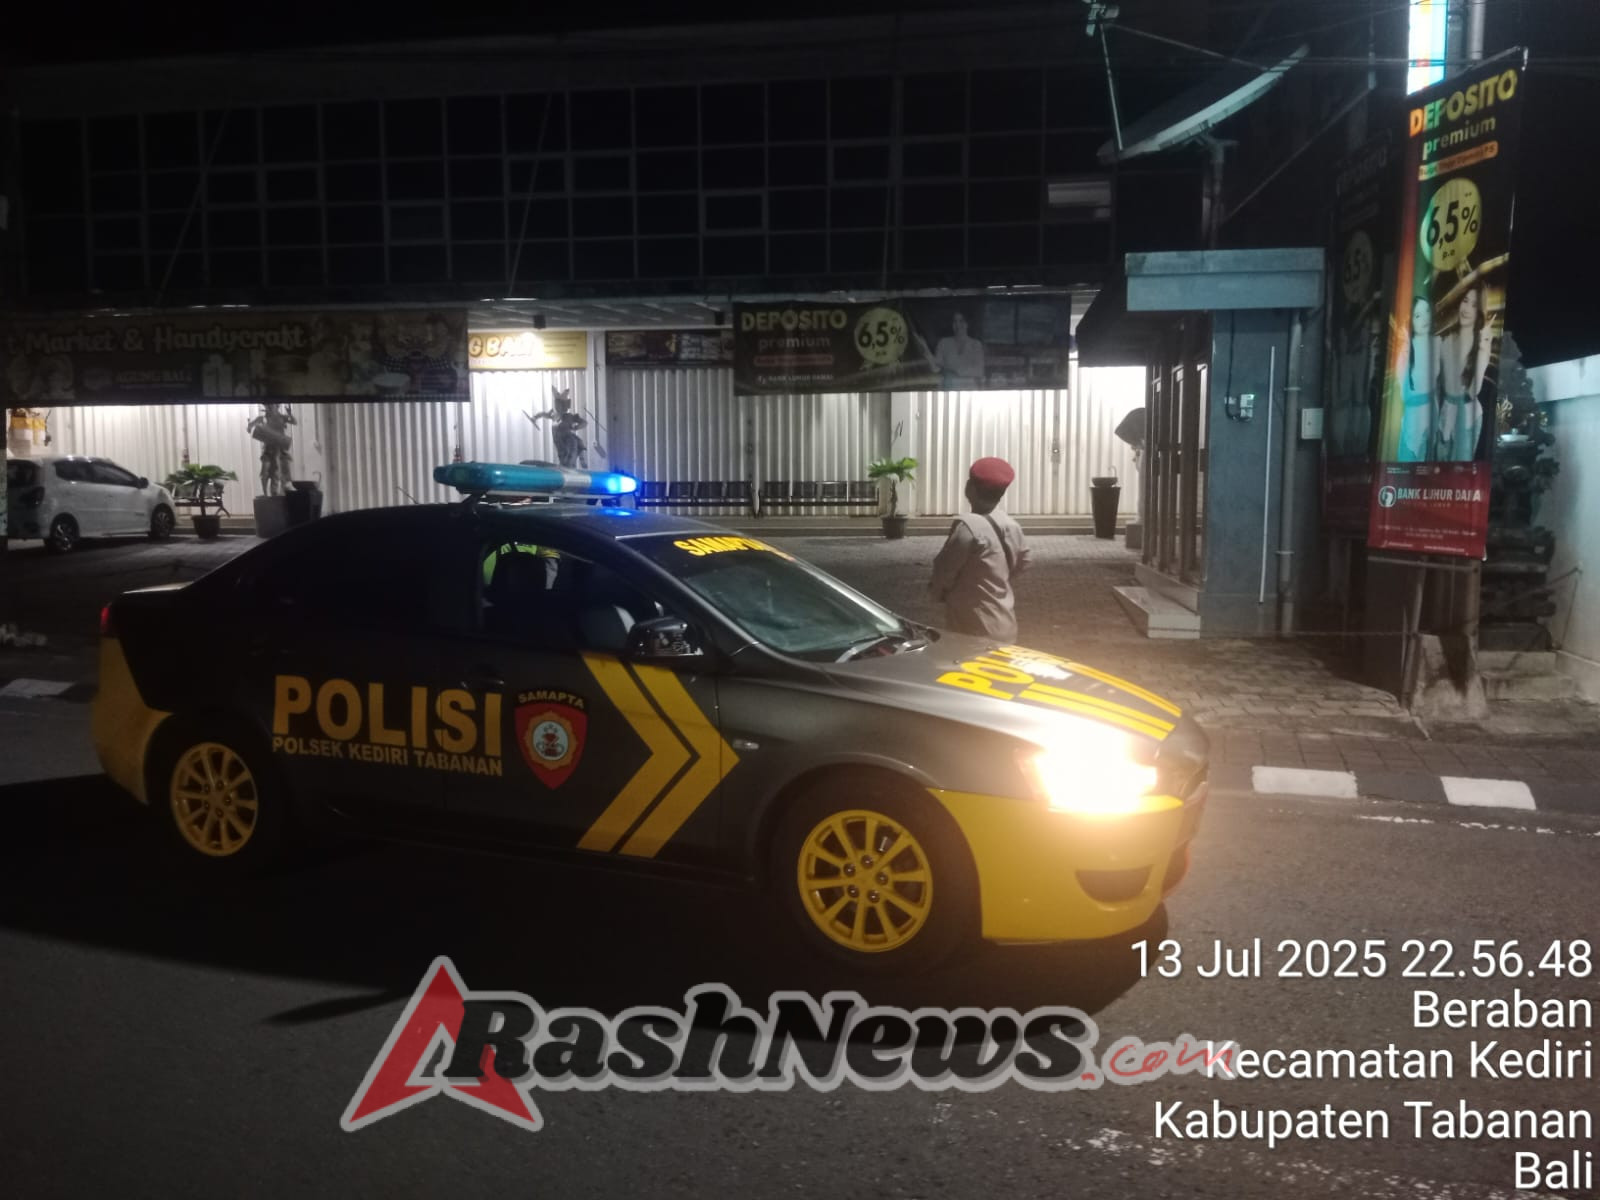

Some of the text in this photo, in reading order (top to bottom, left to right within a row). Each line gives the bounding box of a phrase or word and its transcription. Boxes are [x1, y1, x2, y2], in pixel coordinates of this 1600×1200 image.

[1409, 69, 1518, 138] DEPOSITO
[1422, 117, 1496, 160] premium
[1427, 200, 1478, 249] 6,5%
[741, 310, 847, 331] DEPOSITO
[858, 320, 905, 350] 6,5%
[25, 331, 112, 354] Market
[122, 329, 145, 352] &
[153, 325, 305, 353] Handycraft
[759, 335, 831, 351] premium
[1397, 488, 1421, 500] BANK
[518, 691, 585, 709] SAMAPTA
[272, 674, 502, 757] POLISI
[272, 736, 503, 776] POLSEK KEDIRI TABANAN
